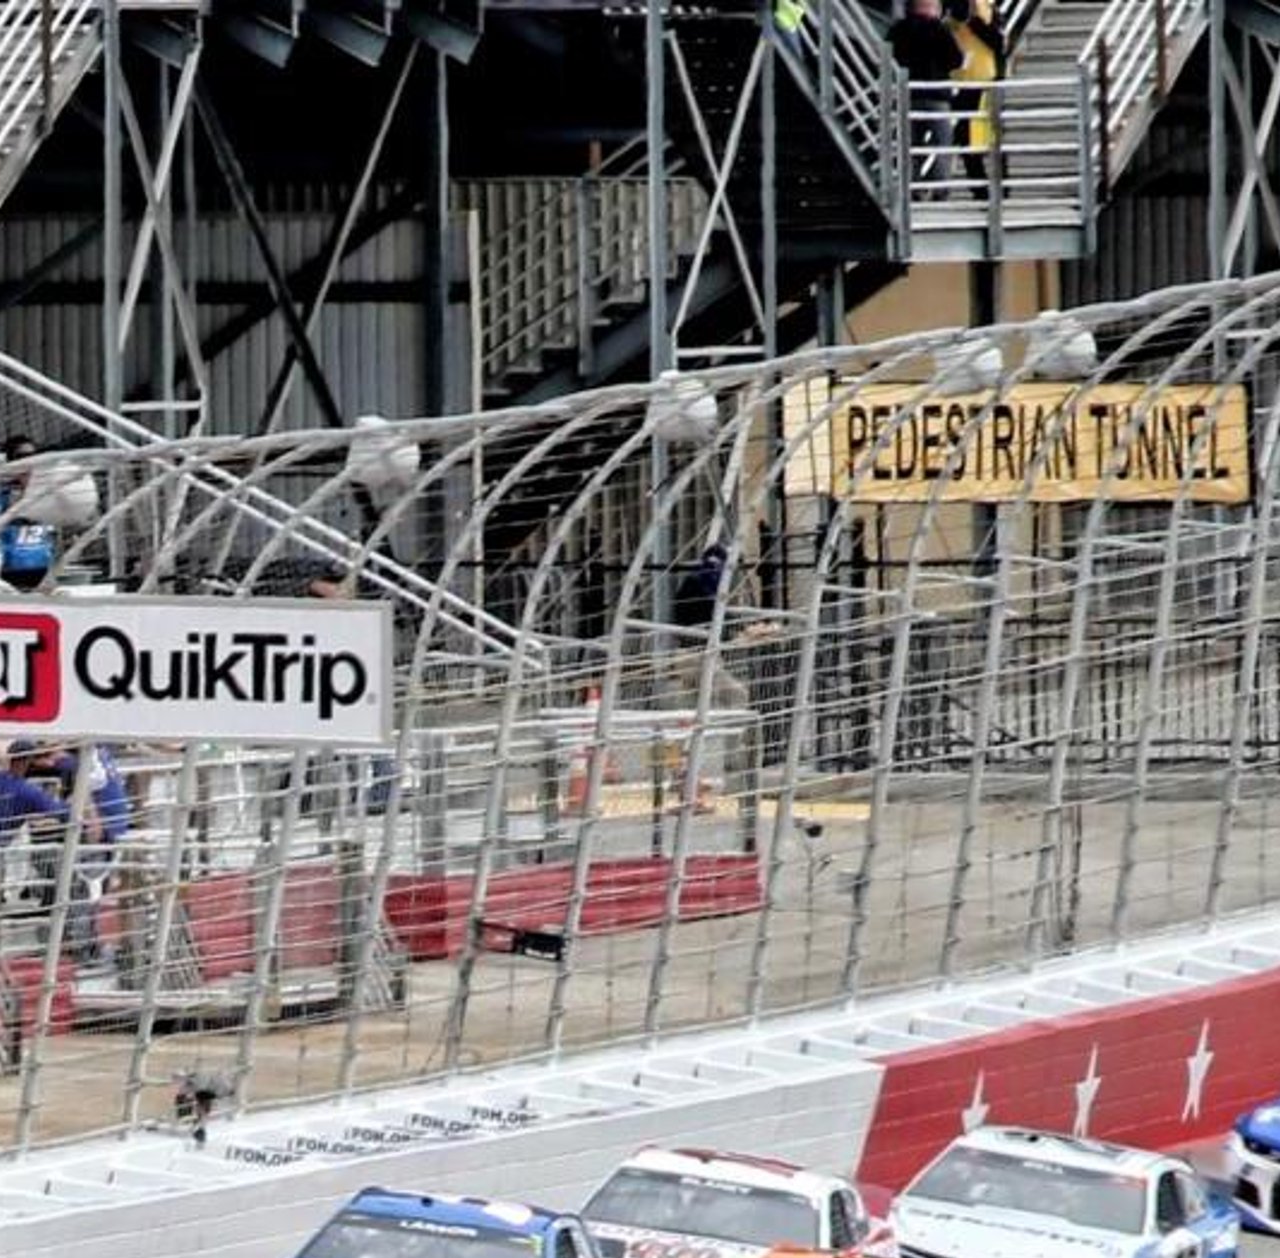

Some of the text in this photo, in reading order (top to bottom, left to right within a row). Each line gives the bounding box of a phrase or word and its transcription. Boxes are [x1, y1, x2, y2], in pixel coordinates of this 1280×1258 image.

[847, 403, 1230, 482] PEDESTRIAN TUNNEL
[74, 625, 368, 720] QuikTrip
